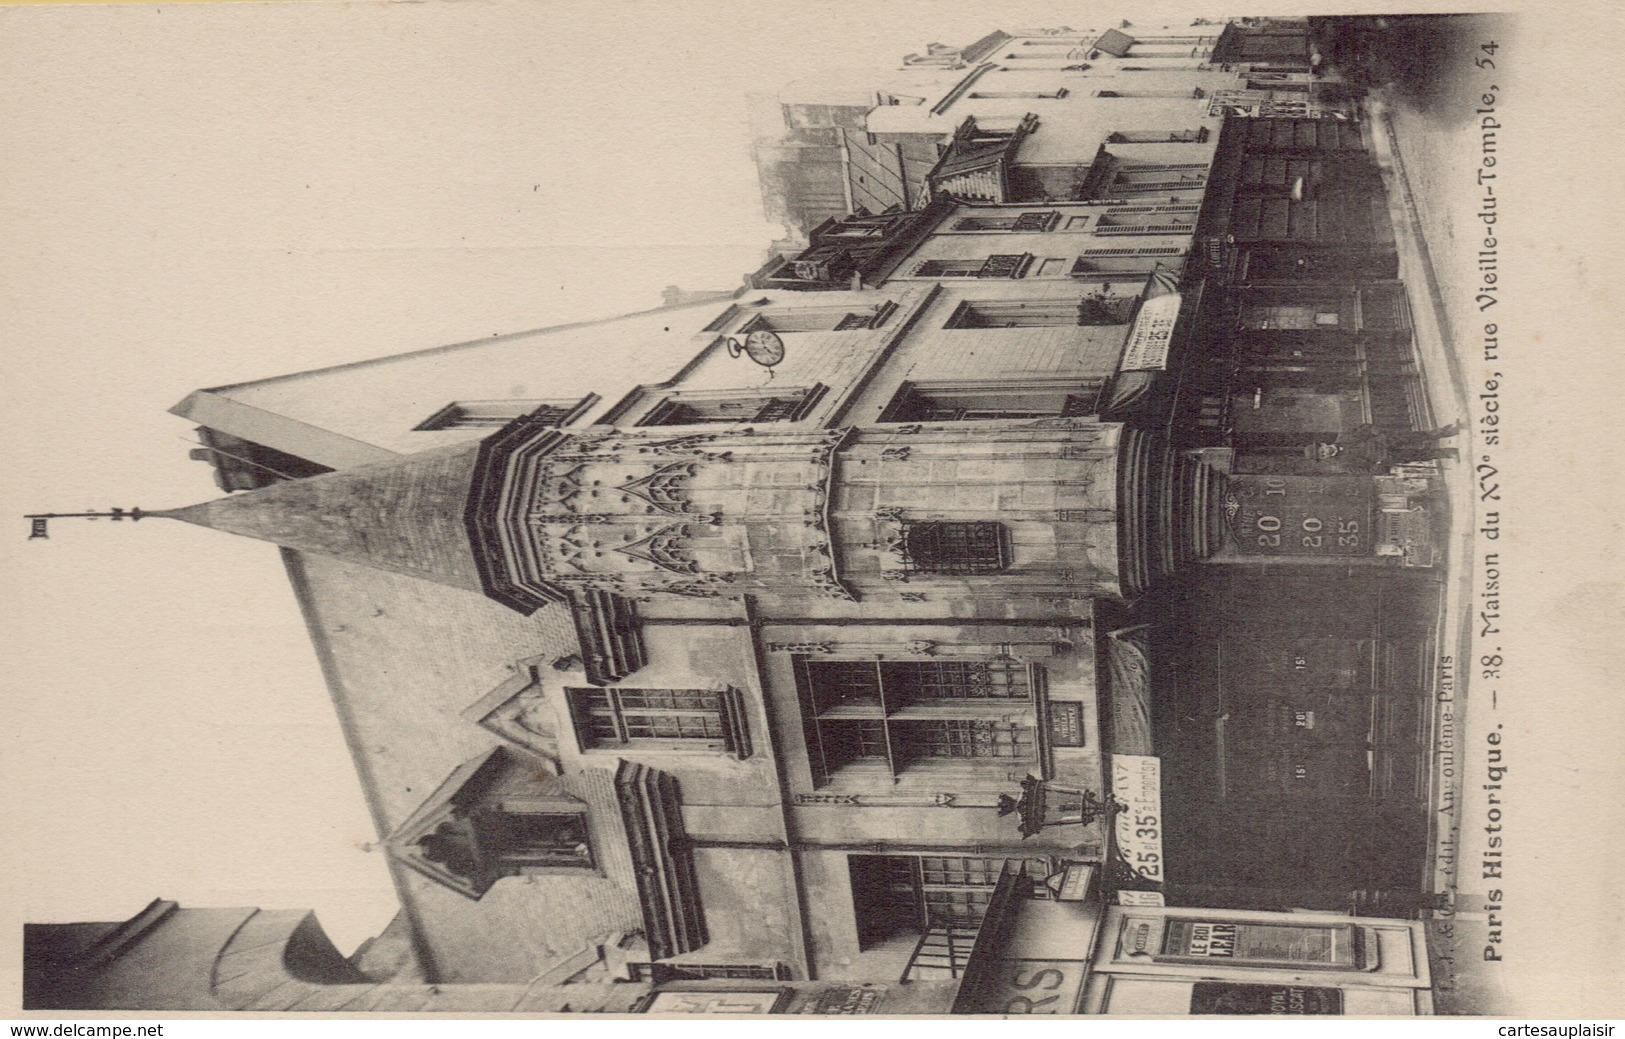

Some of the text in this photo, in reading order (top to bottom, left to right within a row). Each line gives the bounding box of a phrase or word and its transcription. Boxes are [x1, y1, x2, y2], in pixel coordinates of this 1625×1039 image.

[1475, 40, 1499, 70] 54
[1475, 84, 1501, 312] Vieille-du-Temple,
[1482, 323, 1498, 361] rue
[1478, 371, 1503, 445] siècle,
[1480, 512, 1500, 540] du
[1480, 552, 1500, 638] Maison
[1480, 647, 1503, 679] 38.
[1053, 718, 1061, 732] RUE
[1061, 712, 1069, 738] VIEILLE
[1068, 706, 1076, 732] TEMPLE
[1134, 760, 1157, 803] Emporter
[1483, 722, 1507, 879] Historique.
[1139, 841, 1158, 850] et
[1135, 852, 1159, 876] 25
[1190, 925, 1211, 955] LE ROI
[1438, 923, 1455, 938] &
[1483, 889, 1502, 962] Paris
[1208, 924, 1237, 958] LEAR
[1439, 949, 1455, 965] J.
